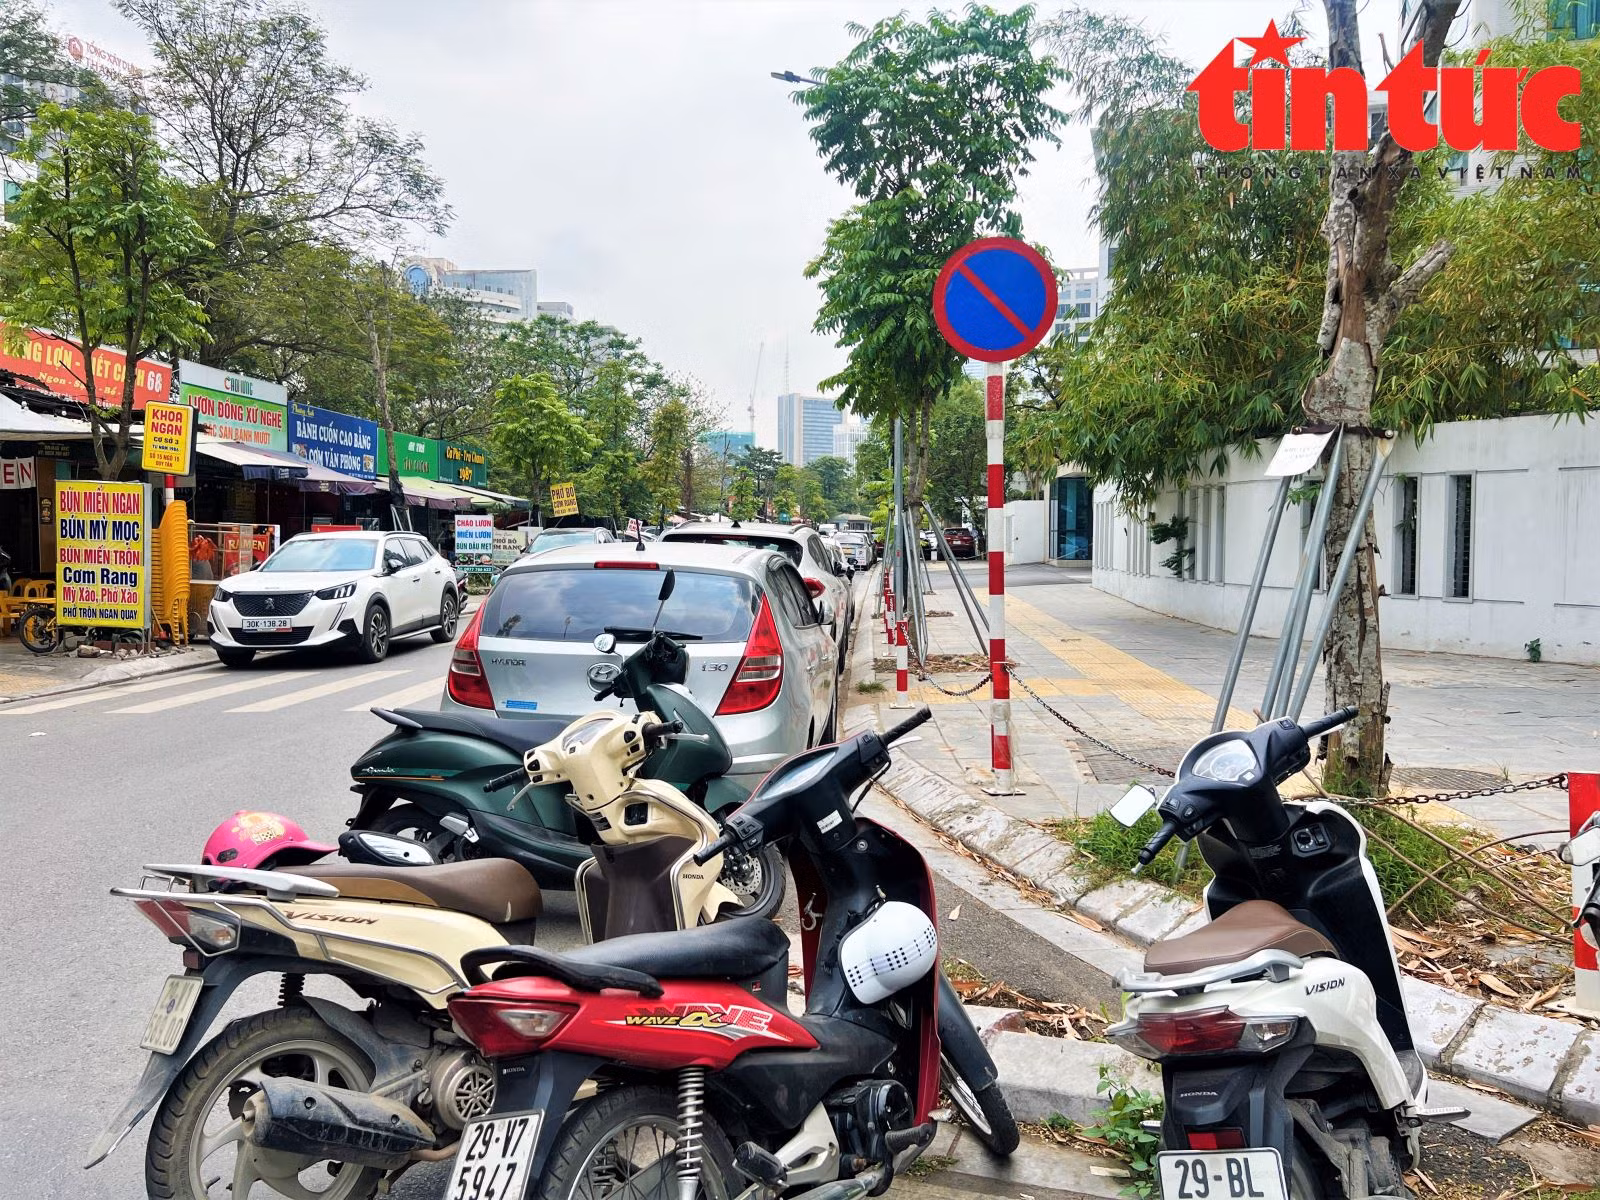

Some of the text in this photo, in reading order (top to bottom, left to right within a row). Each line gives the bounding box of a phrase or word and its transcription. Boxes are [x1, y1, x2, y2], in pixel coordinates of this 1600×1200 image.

[38, 372, 66, 385] Ngon
[46, 346, 72, 370] LỢN
[147, 371, 163, 392] 68
[152, 409, 183, 423] KHOA
[260, 408, 283, 432] NGHỆ
[151, 421, 183, 436] NGAN
[339, 429, 353, 447] CAO
[59, 486, 80, 513] BÚN
[112, 492, 140, 515] NGAN
[60, 514, 140, 546] BÚN MỲ MỌC
[59, 544, 140, 569] BÚN MIẾN TRỘN
[63, 566, 138, 588] Cơm Rang
[62, 586, 77, 604] Mỳ
[101, 586, 119, 604] Phở
[62, 603, 138, 621] PHỞ TRỘN NGAN QUAY
[701, 660, 729, 672] i30
[283, 910, 380, 925] VISION
[1304, 976, 1346, 996] VISION
[625, 1015, 680, 1026] WAVE
[1179, 1090, 1219, 1098] HONDA
[464, 1116, 530, 1161] 29-V7
[456, 1161, 518, 1200] 5947
[1174, 1157, 1265, 1199] 29-BL
